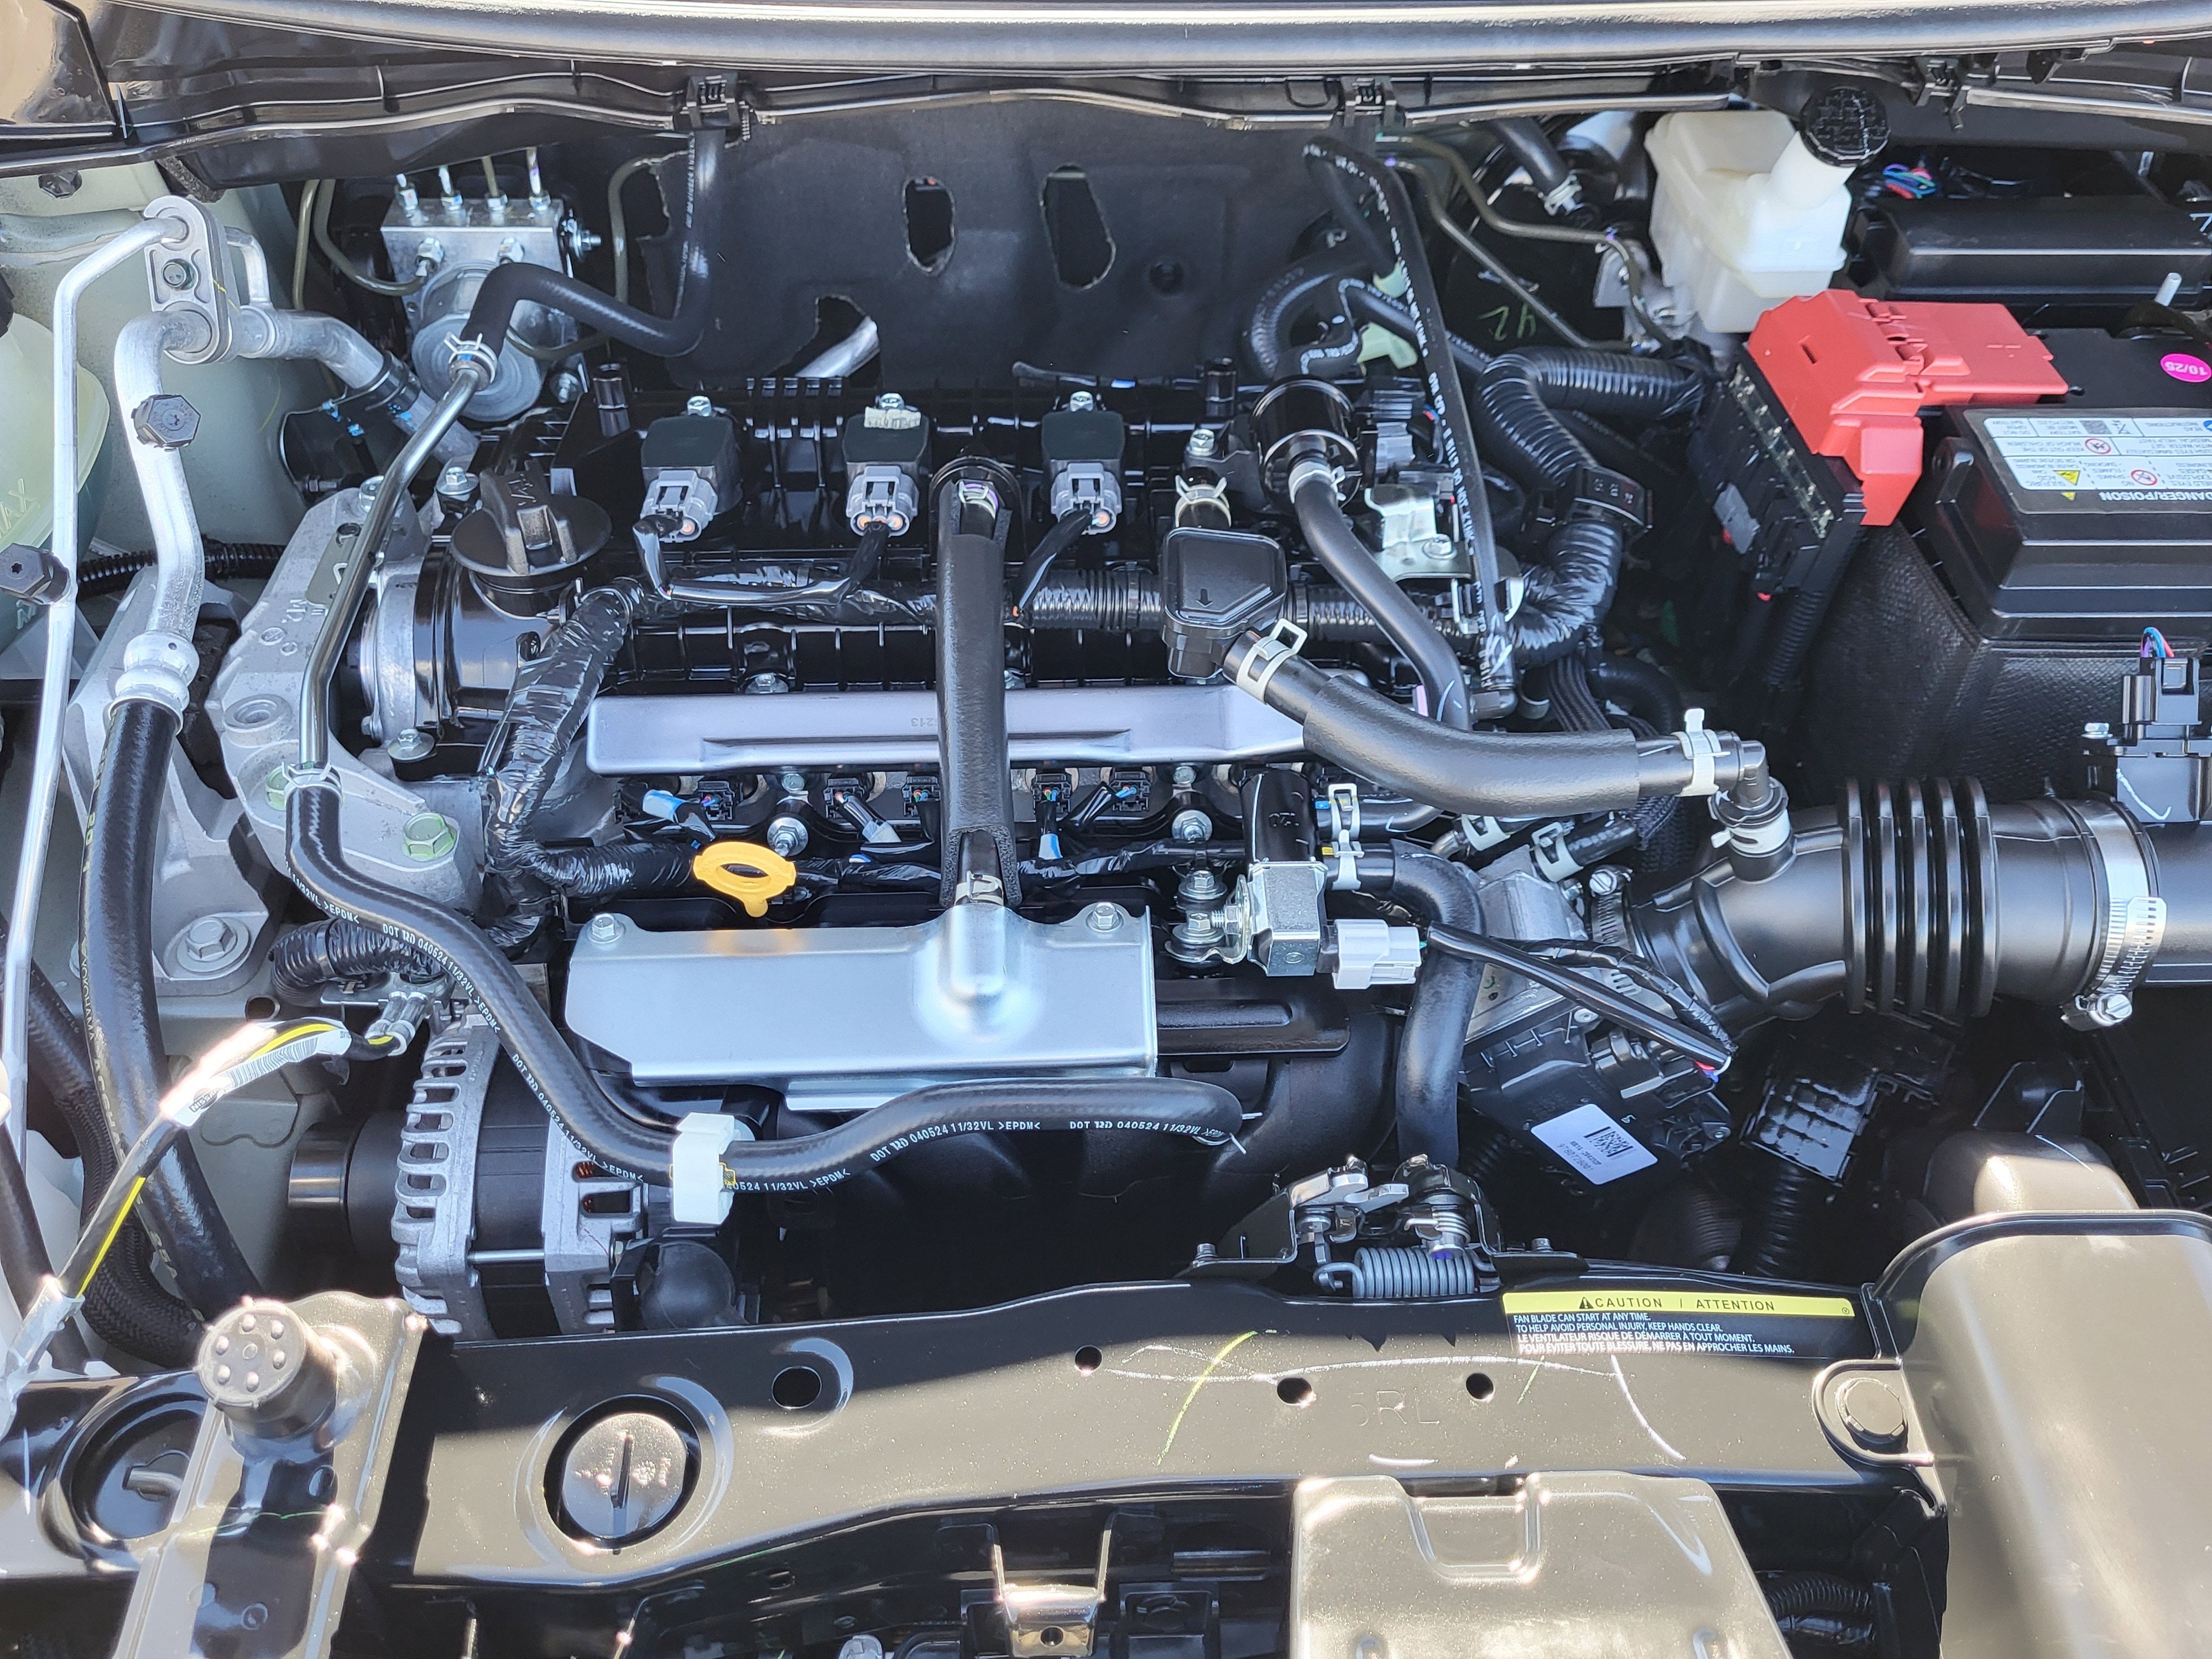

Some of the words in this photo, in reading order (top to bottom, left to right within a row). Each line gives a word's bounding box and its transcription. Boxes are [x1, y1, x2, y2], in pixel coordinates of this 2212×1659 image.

[2164, 361, 2208, 375] 10/25
[0, 478, 36, 539] AX
[323, 899, 359, 925] >EPDM<
[382, 923, 400, 938] DOT
[417, 938, 449, 966] 040524
[447, 960, 476, 998] 11/32VL
[473, 995, 501, 1034] >EPDM<
[512, 1053, 528, 1076] DOT
[538, 1092, 565, 1132] 040524
[563, 1129, 598, 1162] 11/32VL
[601, 1161, 644, 1182] >EPDM<
[1117, 1121, 1160, 1130] 040524
[1163, 1123, 1201, 1135] 11/32VL
[870, 1147, 891, 1162] DOT
[909, 1124, 948, 1143] 040524
[951, 1121, 994, 1133] 11/32VL
[998, 1121, 1041, 1130] >EPDM<
[764, 1182, 808, 1191] 11/32VL
[808, 1168, 851, 1187] >EPDM<
[1595, 1298, 1662, 1308] CAUTION
[1697, 1299, 1775, 1311] ATTENTION
[1513, 1315, 1530, 1323] FAN
[1531, 1314, 1557, 1323] BLADE
[1558, 1313, 1575, 1322] CAN
[1576, 1313, 1600, 1321] START
[1613, 1312, 1629, 1321] ANY
[1516, 1324, 1528, 1333] TO
[1529, 1324, 1549, 1333] HELP
[1551, 1323, 1575, 1332] AVOID
[1577, 1322, 1618, 1331] PERSONAL
[1619, 1322, 1648, 1332] INJURY,
[1648, 1322, 1666, 1330] KEEP
[1668, 1323, 1697, 1331] HANDS
[1697, 1323, 1723, 1332] CLEAR.
[1517, 1334, 1528, 1343] LE
[1530, 1333, 1587, 1342] VENTILATEUR
[1588, 1332, 1620, 1341] RISQUE
[1621, 1332, 1634, 1340] DE
[1636, 1329, 1682, 1340] DÉMARRER
[1683, 1332, 1691, 1340] À
[1714, 1334, 1755, 1343] MOMENT.
[1520, 1344, 1546, 1353] POUR
[1577, 1342, 1607, 1351] TOUTE
[1608, 1341, 1652, 1352] BLESSURE,
[1652, 1342, 1664, 1351] NE
[1666, 1342, 1682, 1351] PAS
[1683, 1343, 1695, 1352] EN
[1697, 1343, 1748, 1352] APPROCHER
[1748, 1344, 1763, 1353] LES
[1764, 1344, 1794, 1354] MAINS.
